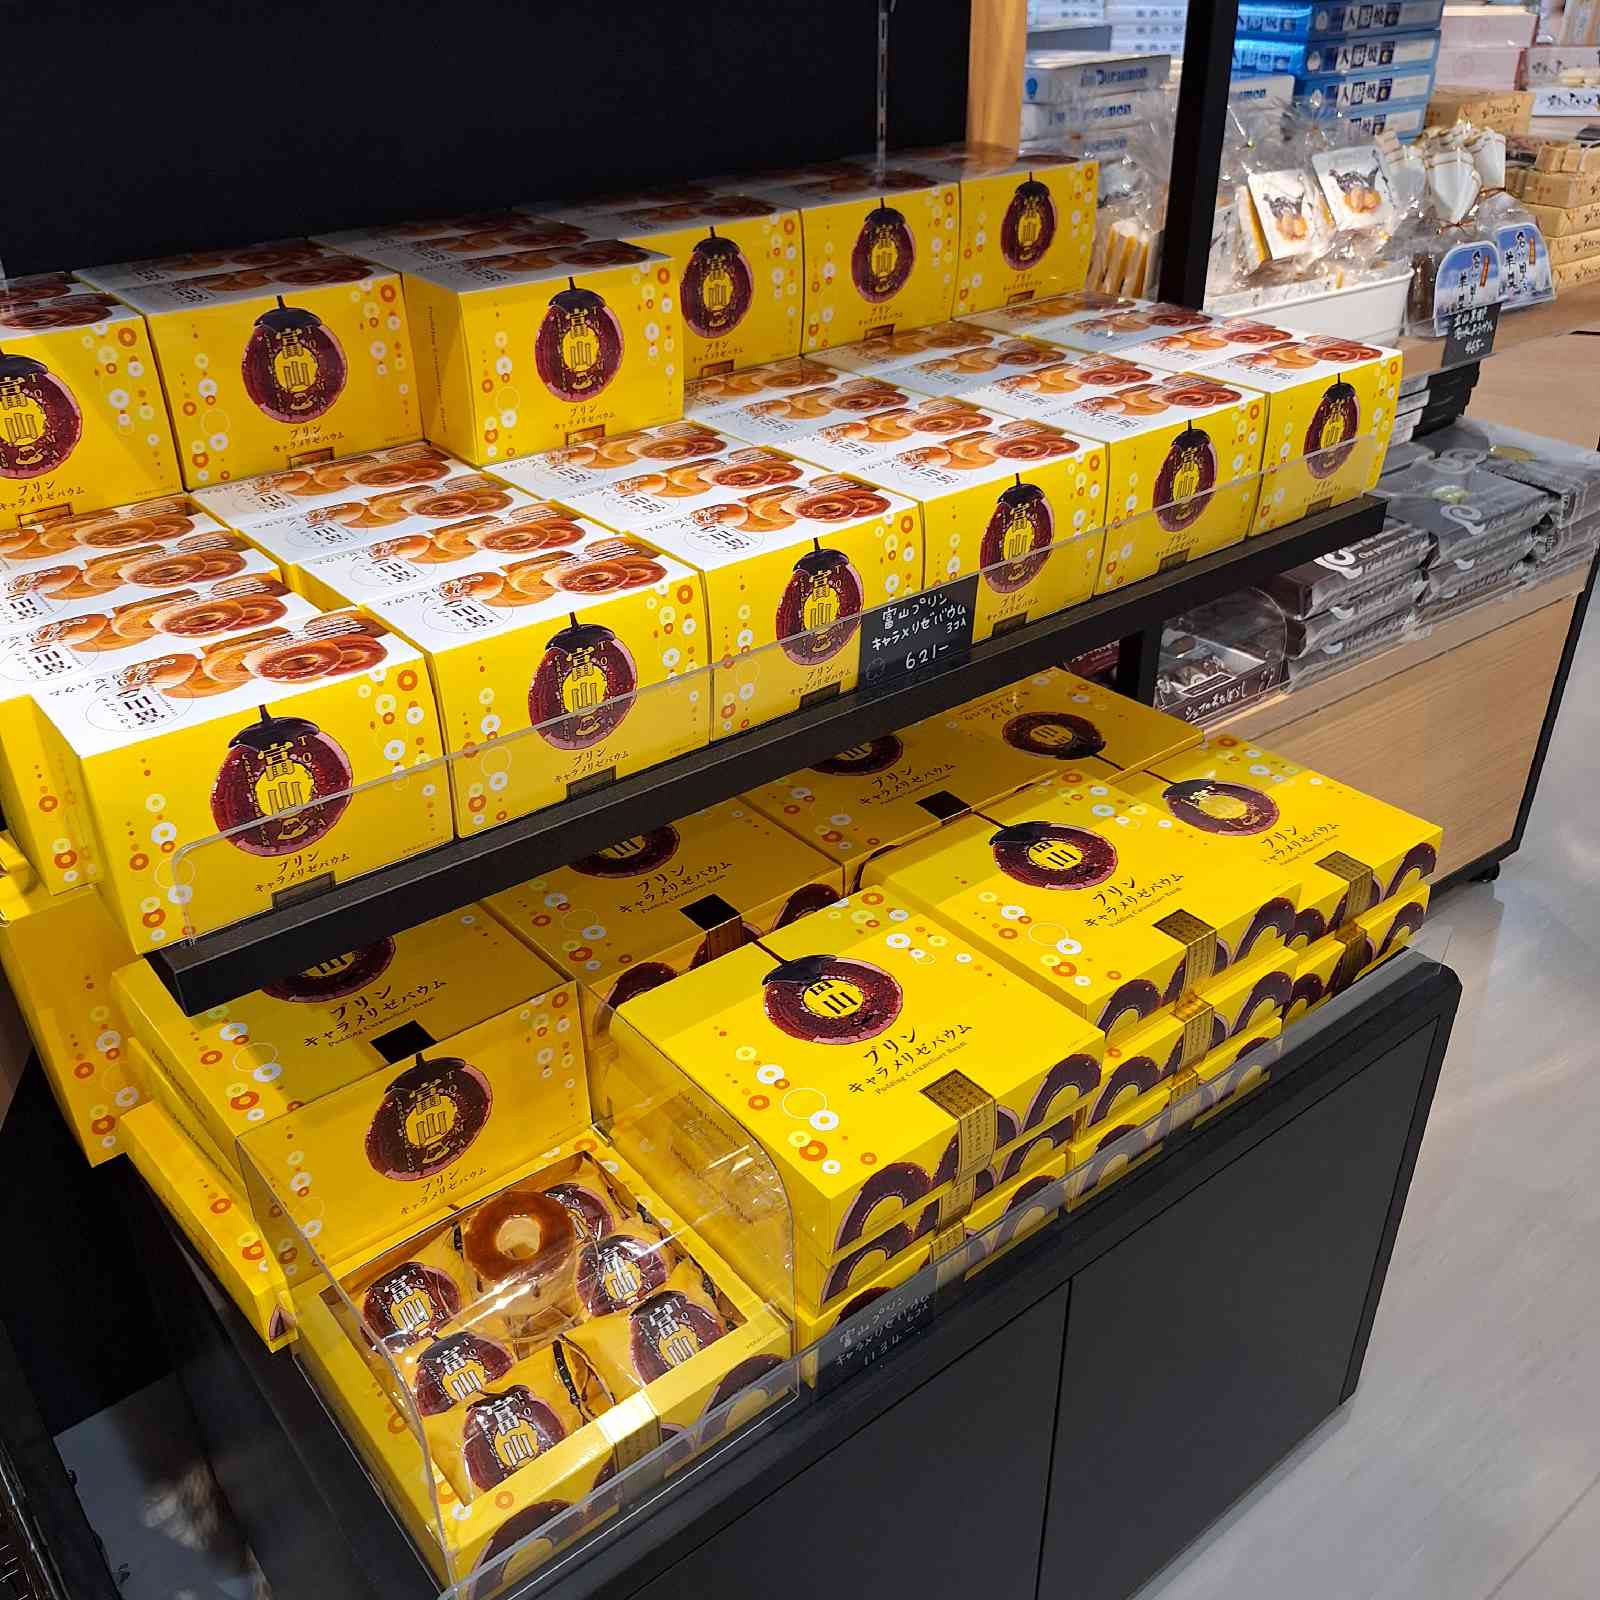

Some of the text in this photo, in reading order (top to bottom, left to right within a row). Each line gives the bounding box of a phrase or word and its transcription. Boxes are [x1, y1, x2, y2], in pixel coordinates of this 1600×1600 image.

[276, 328, 310, 390] 富山
[566, 309, 592, 370] 富山
[17, 480, 56, 496] プリン
[809, 569, 833, 630] 富山
[882, 593, 949, 631] 富山プリン
[872, 604, 968, 651] キャラメリゼバウム
[567, 646, 598, 713] 富山
[258, 741, 306, 815] 富山
[573, 746, 608, 765] プリン
[871, 765, 913, 789] プリン
[278, 851, 320, 875] プリン
[1260, 825, 1298, 849] プリン
[616, 862, 734, 913] キャラメリゼバウム
[636, 864, 685, 894] プリン
[1084, 873, 1186, 927] キャラメリゼバウム
[1093, 875, 1136, 906] プリン
[303, 980, 449, 1048] キャラメリゼバウム
[331, 985, 392, 1021] プリン
[848, 1023, 974, 1094] キャラメリゼバウム
[863, 1023, 918, 1066] プリン
[408, 1078, 448, 1147] 富山
[383, 1274, 430, 1331] 富山
[649, 1300, 696, 1365] 富山
[436, 1345, 483, 1401] 富山
[486, 1396, 535, 1468] 富山
